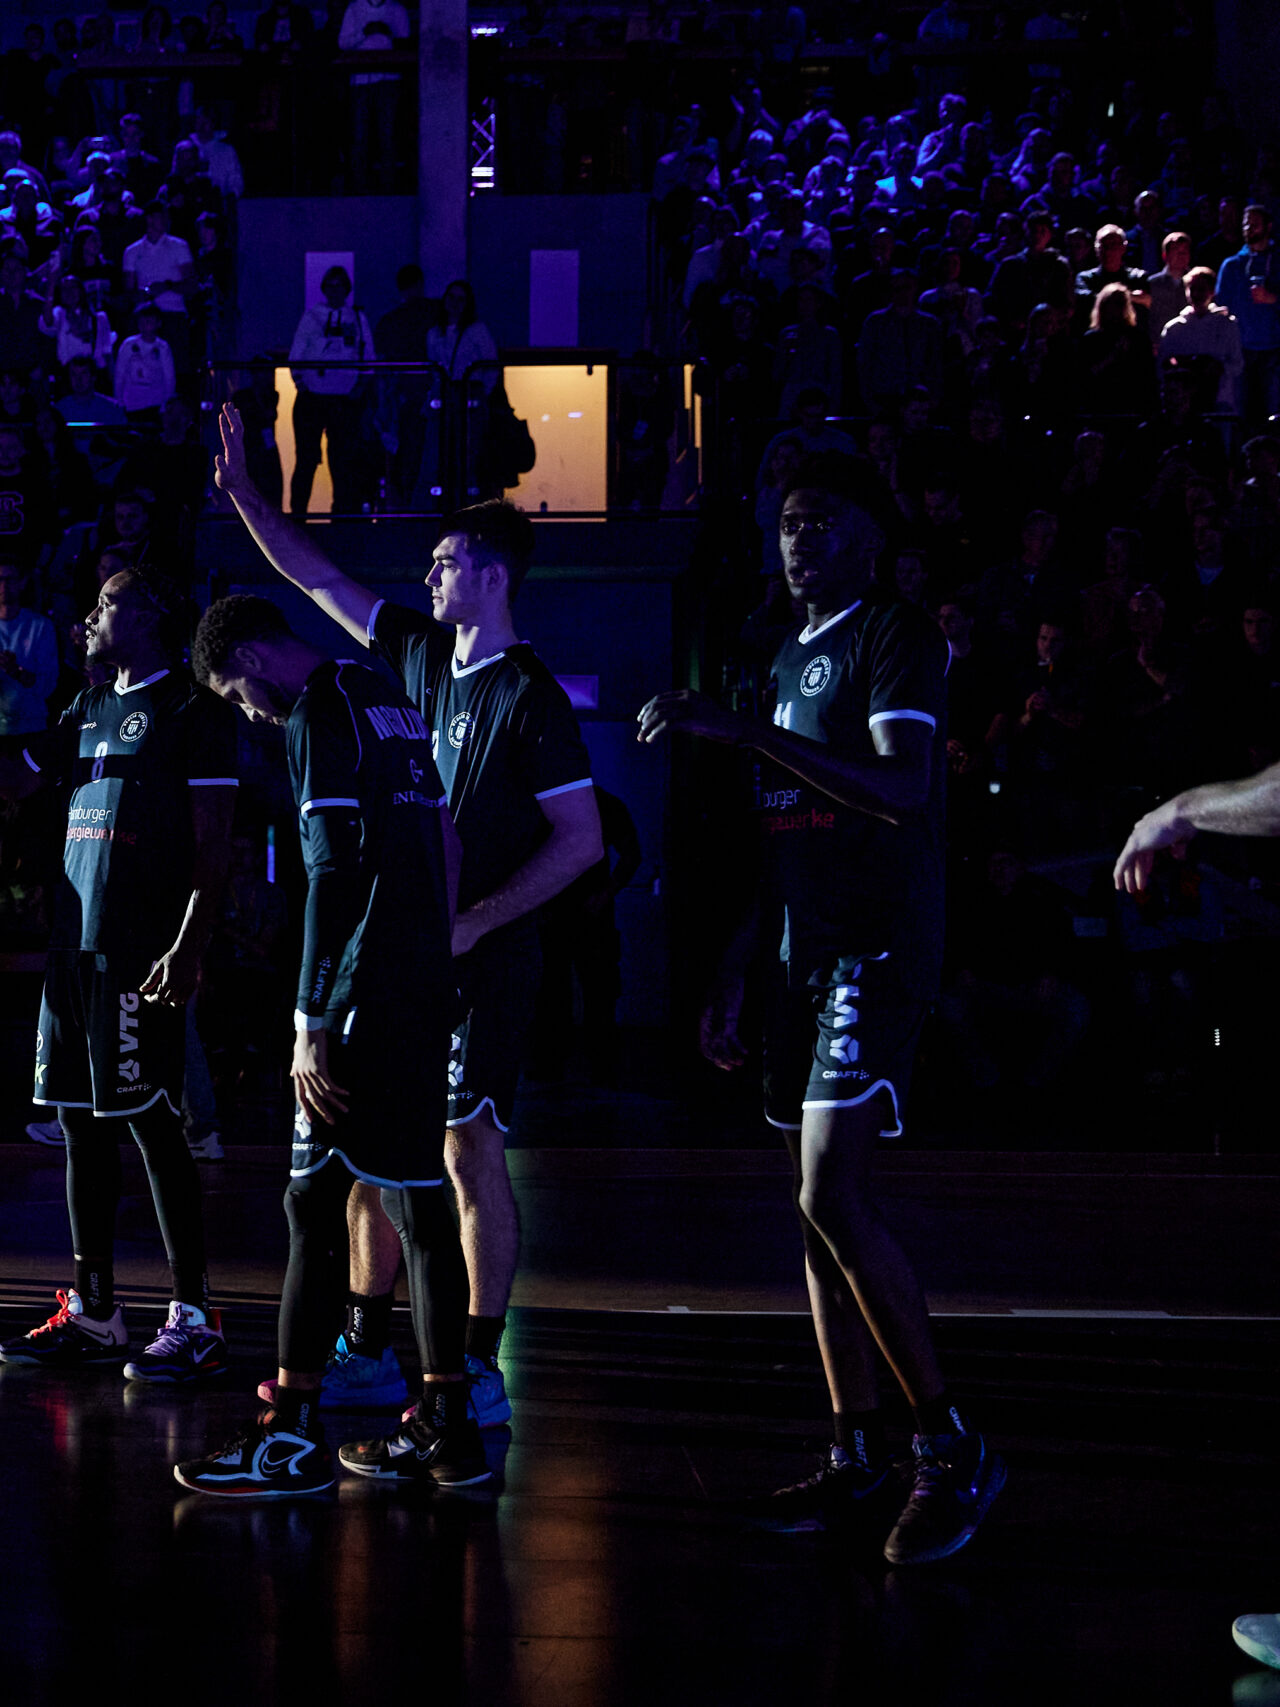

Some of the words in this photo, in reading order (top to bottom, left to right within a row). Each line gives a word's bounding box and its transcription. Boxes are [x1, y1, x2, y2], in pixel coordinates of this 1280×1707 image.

[91, 741, 108, 783] 8
[120, 992, 139, 1053] VTG
[822, 1071, 858, 1079] CRAFT
[116, 1084, 143, 1094] CRAFT
[292, 1142, 314, 1150] CRAFT
[90, 1273, 100, 1298] CRAFT
